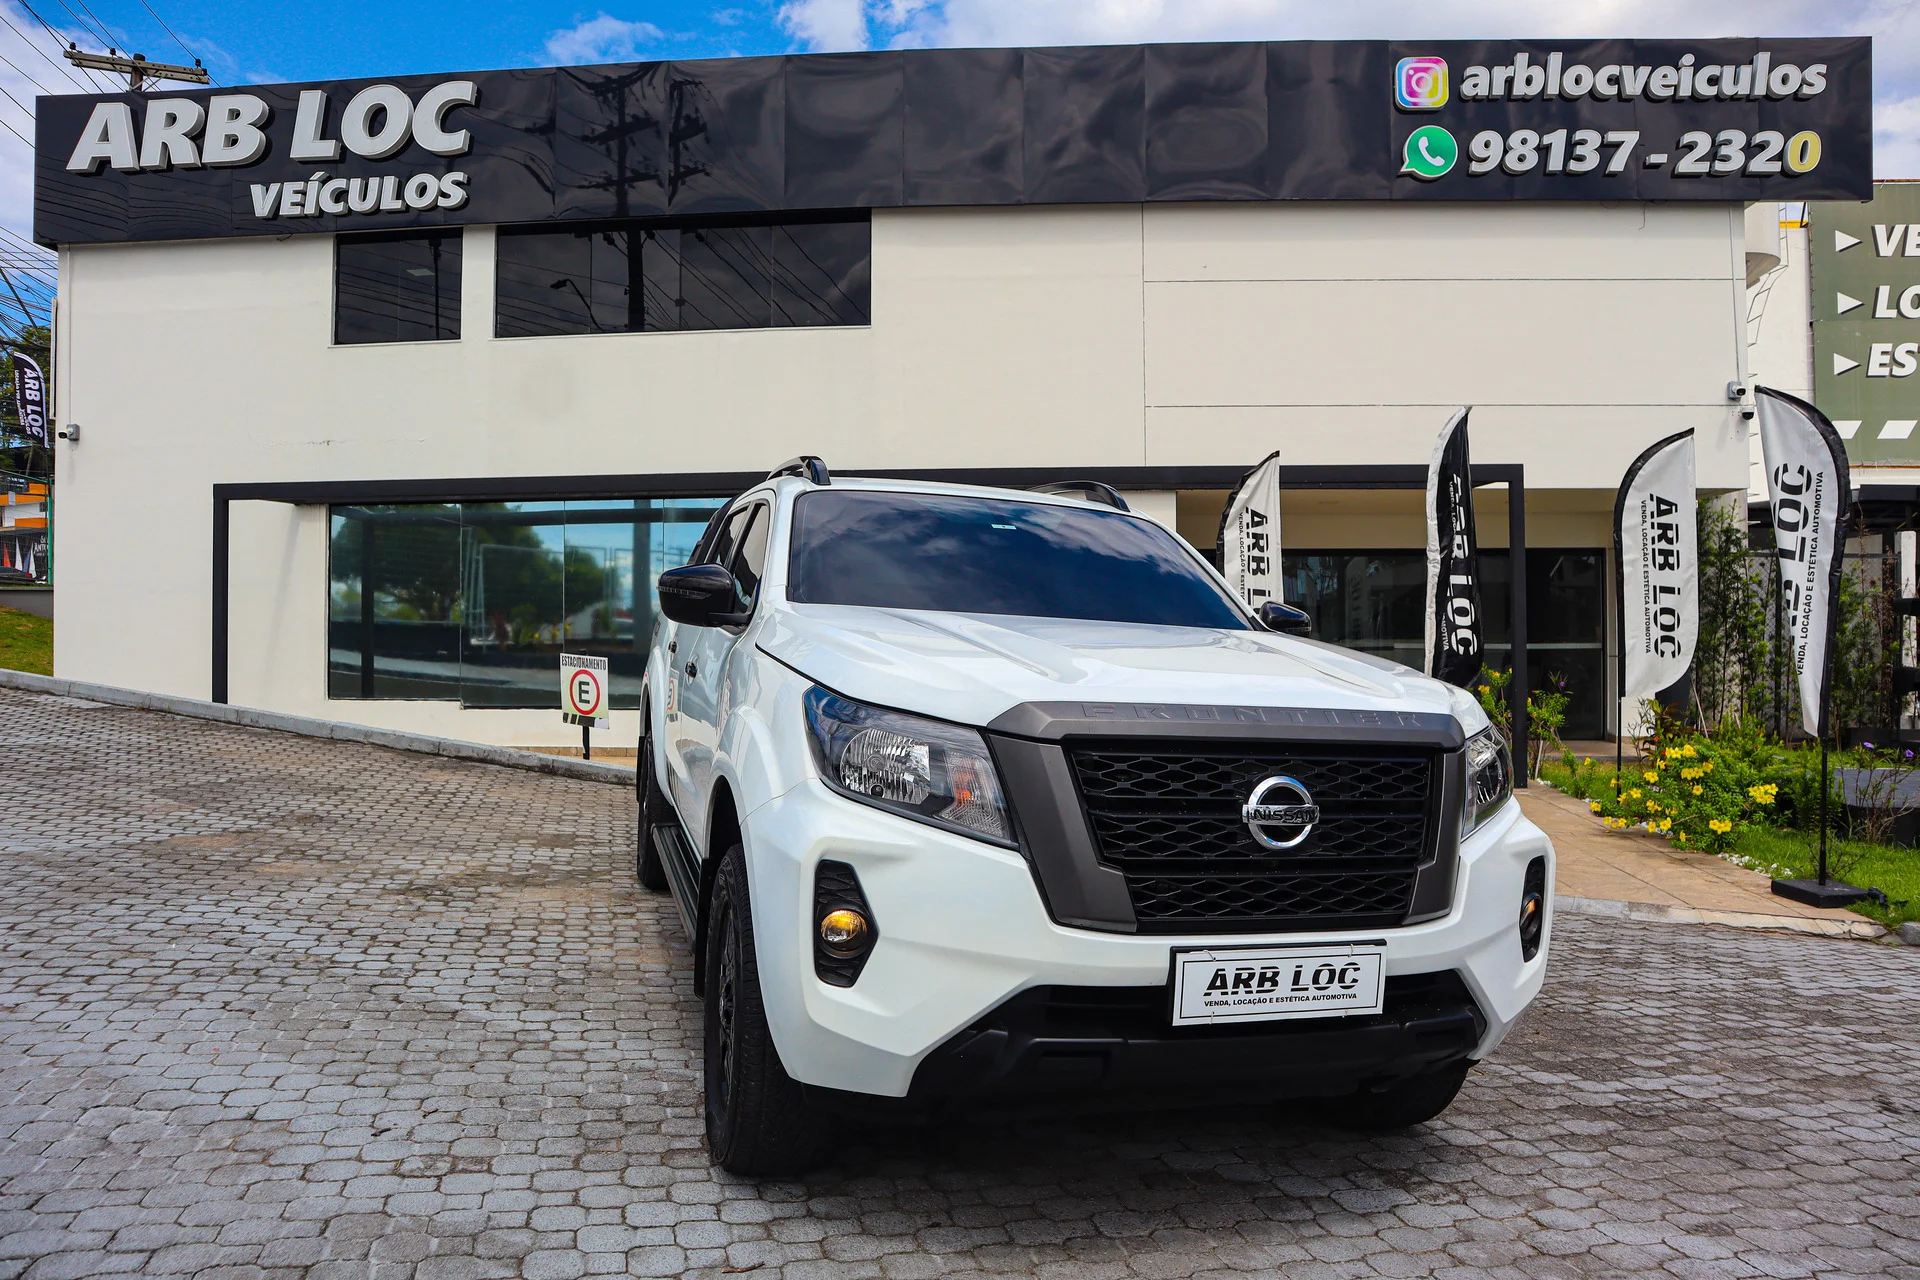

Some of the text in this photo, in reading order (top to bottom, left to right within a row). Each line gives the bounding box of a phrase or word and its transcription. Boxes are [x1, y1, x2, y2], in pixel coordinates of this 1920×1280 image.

[1460, 51, 1828, 100] arblocveiculos
[66, 80, 479, 173] ARB LOC
[249, 171, 470, 219] VEÍCULOS
[1866, 342, 1920, 378] ES
[24, 368, 44, 438] ARB LOC
[1773, 463, 1812, 562] LOC
[1814, 471, 1823, 534] AUTOMOTIVA
[1246, 507, 1270, 576] ARB
[1808, 537, 1818, 583] ESTÉTICA
[1650, 493, 1681, 659] ARB LOC
[1447, 575, 1478, 656] LOC
[1800, 595, 1812, 639] LOCAÇÃO
[562, 655, 607, 670] ESTACIONAMENTO
[1798, 641, 1808, 676] VENDA,
[579, 681, 590, 704] E
[1081, 702, 1422, 728] FRONTIER
[1253, 807, 1318, 823] NISSAN
[1203, 962, 1361, 997] ARB LOC
[1233, 997, 1268, 1006] LOCAÇÃO
[1275, 995, 1310, 1003] ESTÉTICA
[1311, 993, 1357, 1001] AUTOMOTIVA
